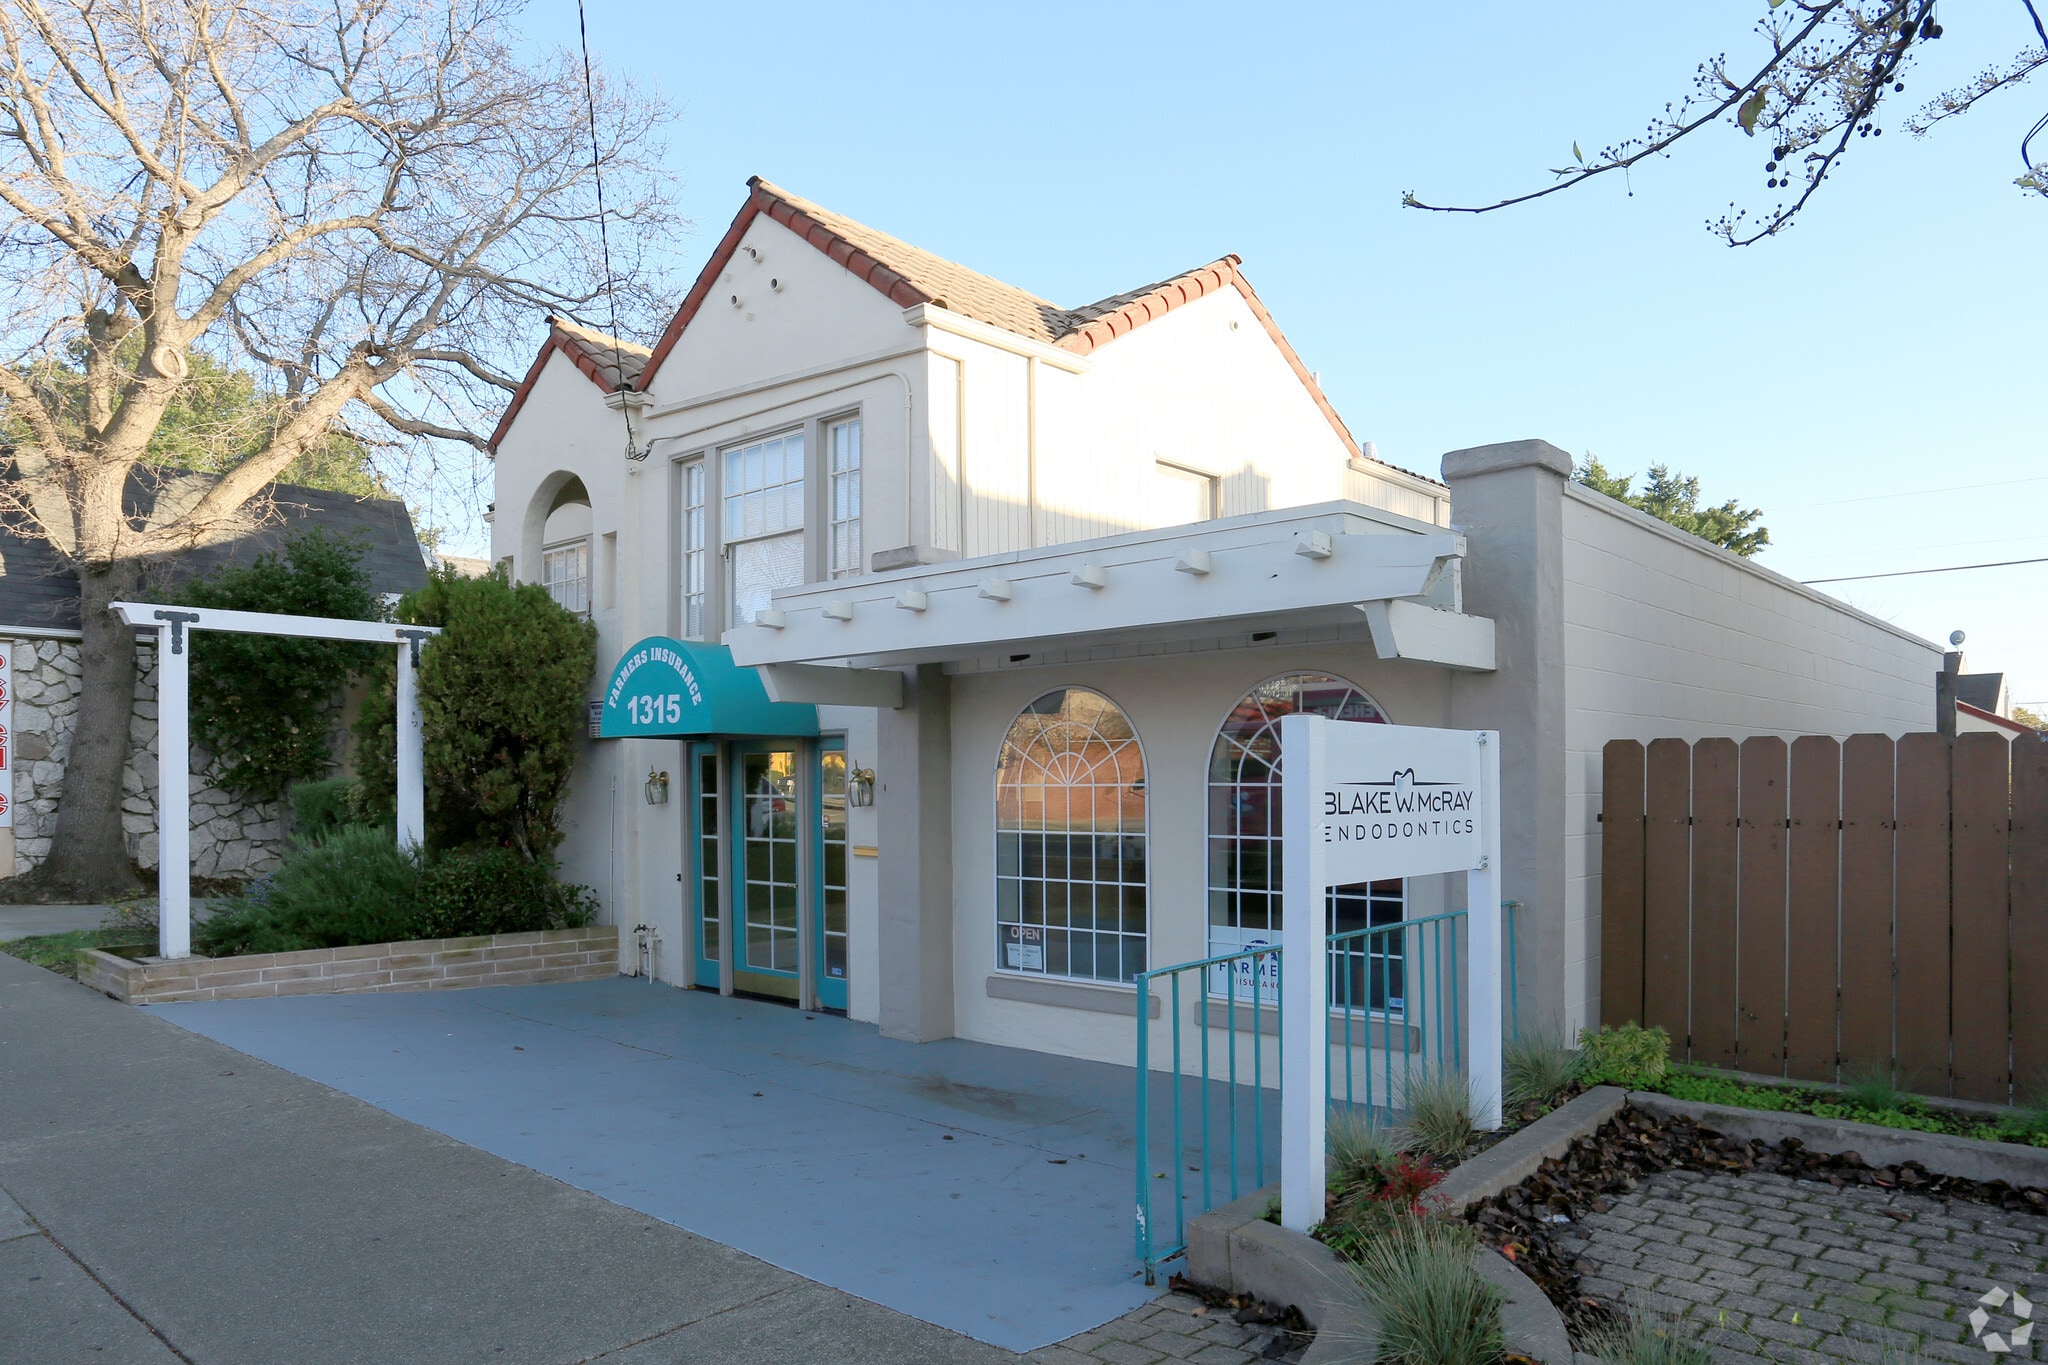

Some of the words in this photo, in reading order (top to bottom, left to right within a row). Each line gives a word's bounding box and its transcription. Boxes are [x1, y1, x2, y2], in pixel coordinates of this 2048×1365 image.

[608, 649, 648, 709] FARMERS
[650, 647, 702, 706] INSURANCE
[627, 694, 681, 725] 1315
[1324, 791, 1392, 815] BLAKE
[1394, 791, 1415, 813] W.
[1417, 790, 1474, 813] McRAY
[1324, 819, 1474, 843] ENDODONTICS
[1010, 926, 1040, 941] OPEN
